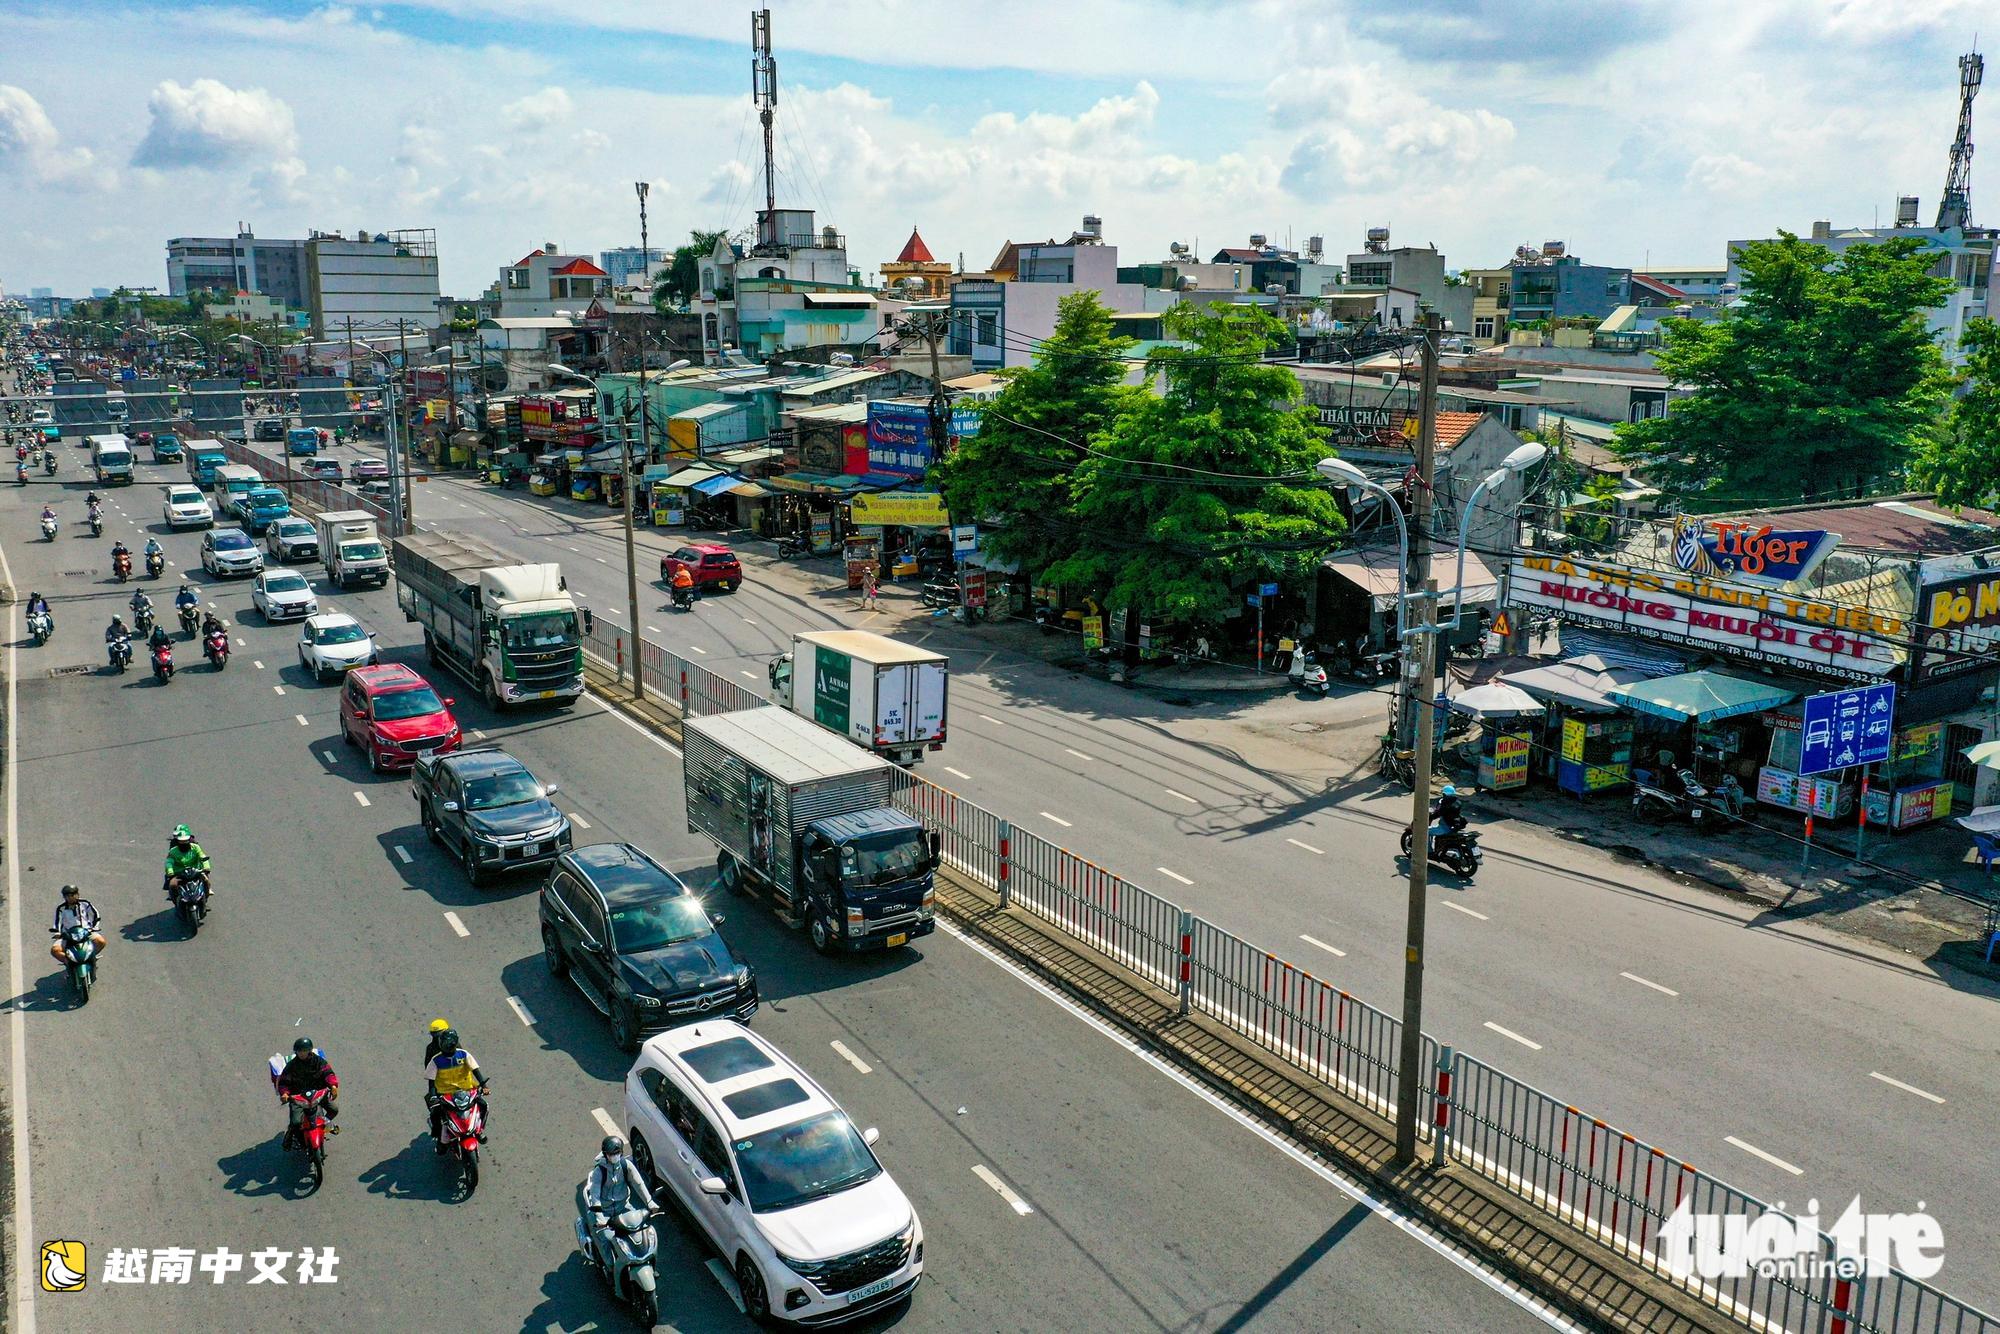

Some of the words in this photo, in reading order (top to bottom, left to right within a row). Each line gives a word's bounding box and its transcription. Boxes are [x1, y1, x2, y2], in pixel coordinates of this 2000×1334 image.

[1712, 522, 1808, 575] Tiger
[535, 653, 556, 661] JAC
[882, 902, 907, 914] ISUZU
